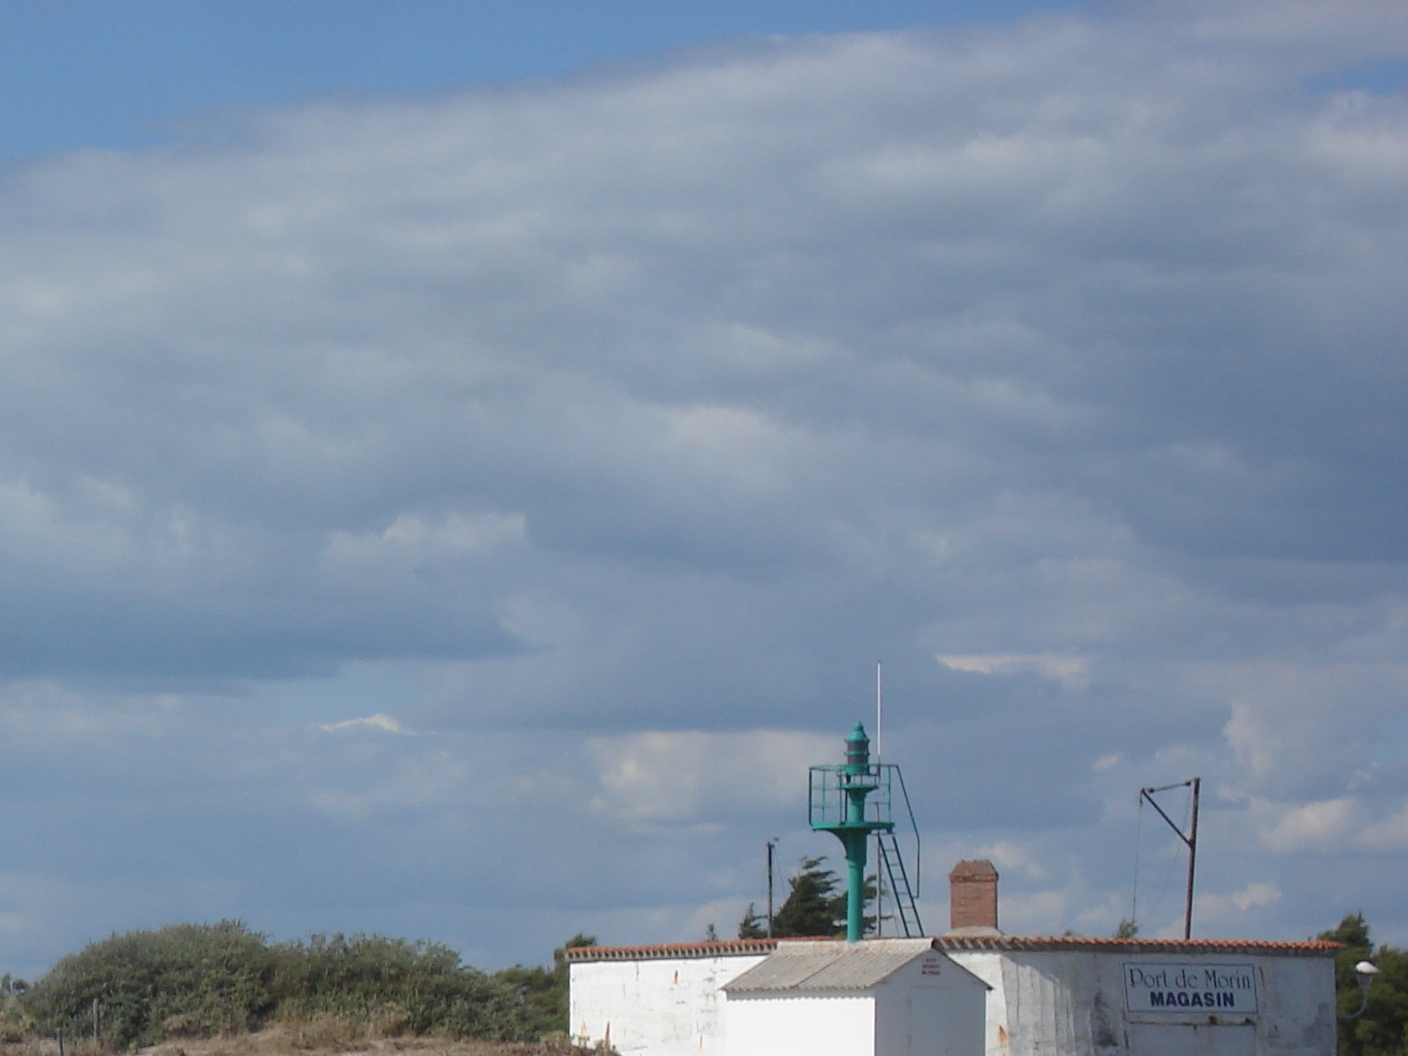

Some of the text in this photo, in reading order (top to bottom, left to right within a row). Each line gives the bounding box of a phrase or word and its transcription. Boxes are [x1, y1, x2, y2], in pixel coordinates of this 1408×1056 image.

[1129, 968, 1251, 990] Port de Morin
[1149, 991, 1235, 1007] MAGASIN
